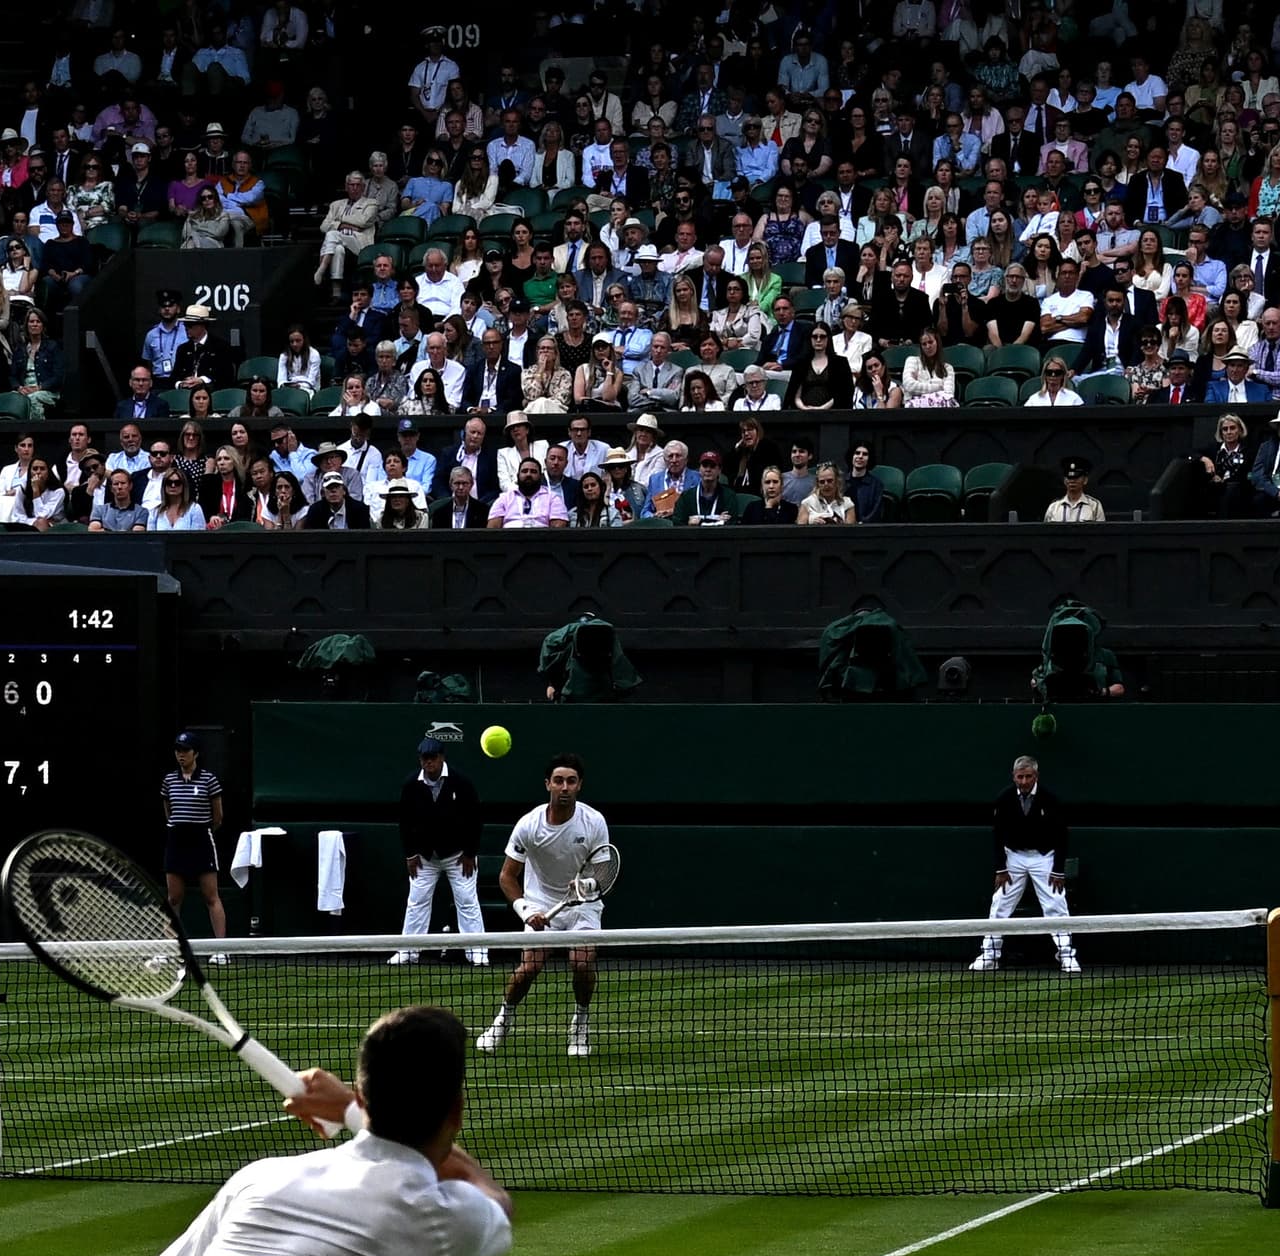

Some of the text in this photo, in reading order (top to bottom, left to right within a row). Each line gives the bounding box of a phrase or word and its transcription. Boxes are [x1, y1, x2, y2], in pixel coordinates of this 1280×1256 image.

[443, 23, 481, 49] 09
[194, 283, 250, 312] 206
[68, 609, 114, 629] 1:42
[8, 653, 15, 664] 2
[40, 653, 48, 664] 3
[72, 653, 80, 664] 4
[105, 653, 113, 664] 5
[4, 681, 20, 705] 6
[35, 680, 53, 706] 0
[3, 760, 21, 785] 7
[20, 785, 28, 796] 7
[37, 760, 50, 785] 1
